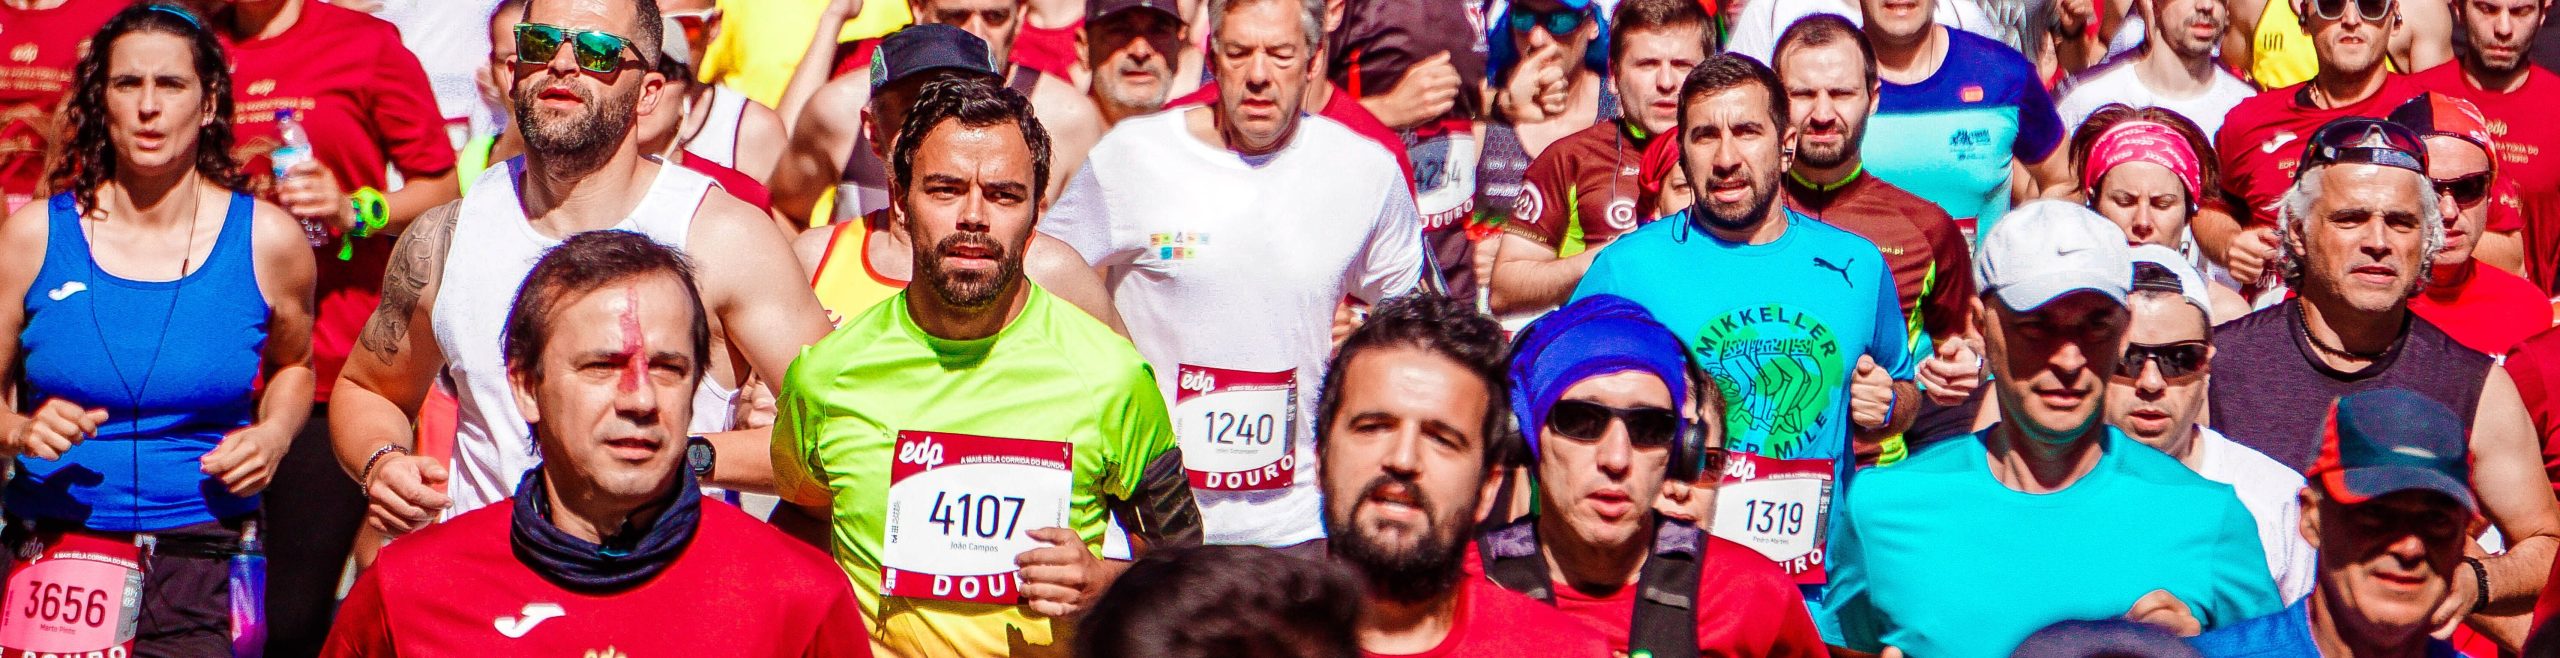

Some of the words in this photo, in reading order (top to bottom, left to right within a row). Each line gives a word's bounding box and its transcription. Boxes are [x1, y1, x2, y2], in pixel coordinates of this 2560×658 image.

[1696, 306, 1837, 358] MIKKELLER
[1180, 370, 1215, 397] edp
[1205, 411, 1275, 445] 1240
[1774, 411, 1828, 461] MILE
[899, 436, 944, 471] edp
[960, 455, 967, 464] A
[966, 454, 982, 464] MAIS
[982, 454, 1000, 464] BELA
[1000, 455, 1031, 467] CORRIDA
[1030, 457, 1041, 467] DO
[1041, 458, 1066, 471] MUNDO
[1206, 454, 1295, 489] DOURO
[928, 491, 1026, 540] 4107
[1746, 499, 1804, 536] 1319
[968, 542, 999, 554] Campos
[24, 580, 109, 629] 3656
